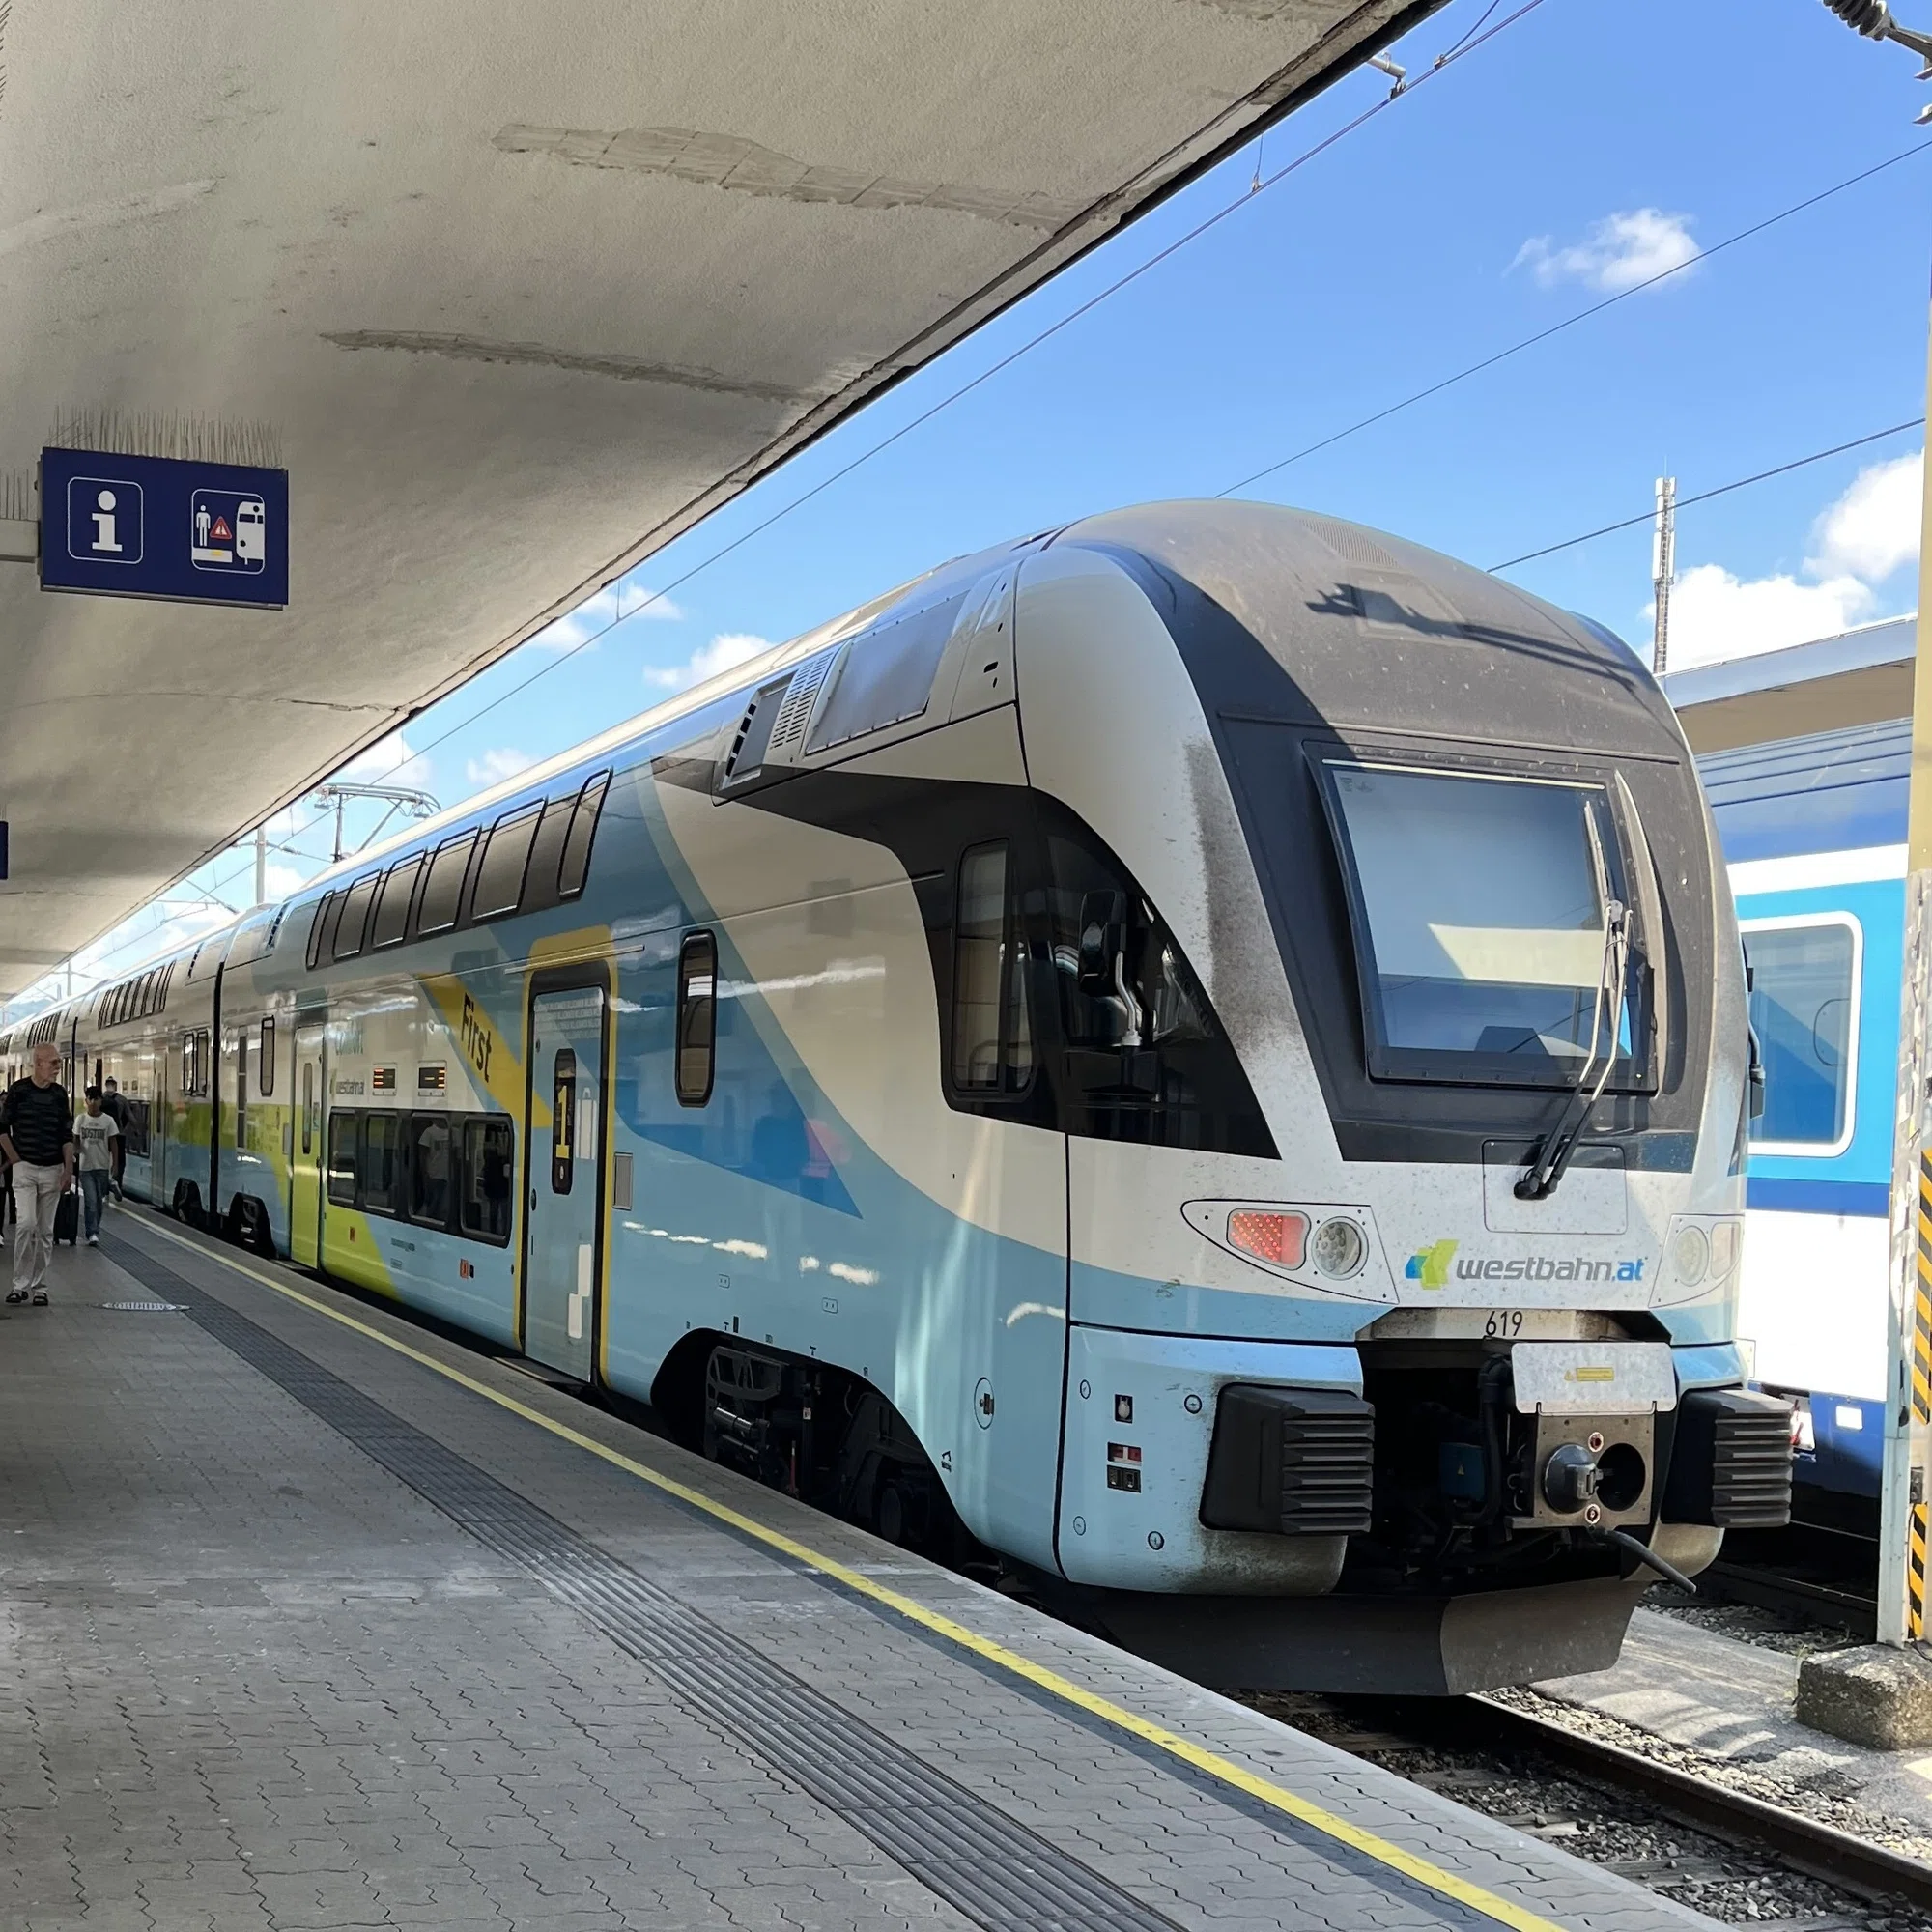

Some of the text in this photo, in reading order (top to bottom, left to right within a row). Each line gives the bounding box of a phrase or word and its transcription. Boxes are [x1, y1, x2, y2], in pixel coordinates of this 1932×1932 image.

[461, 992, 492, 1083] First
[555, 1085, 570, 1159] 1
[1456, 1257, 1644, 1282] westbahn.at
[1485, 1310, 1523, 1337] 619
